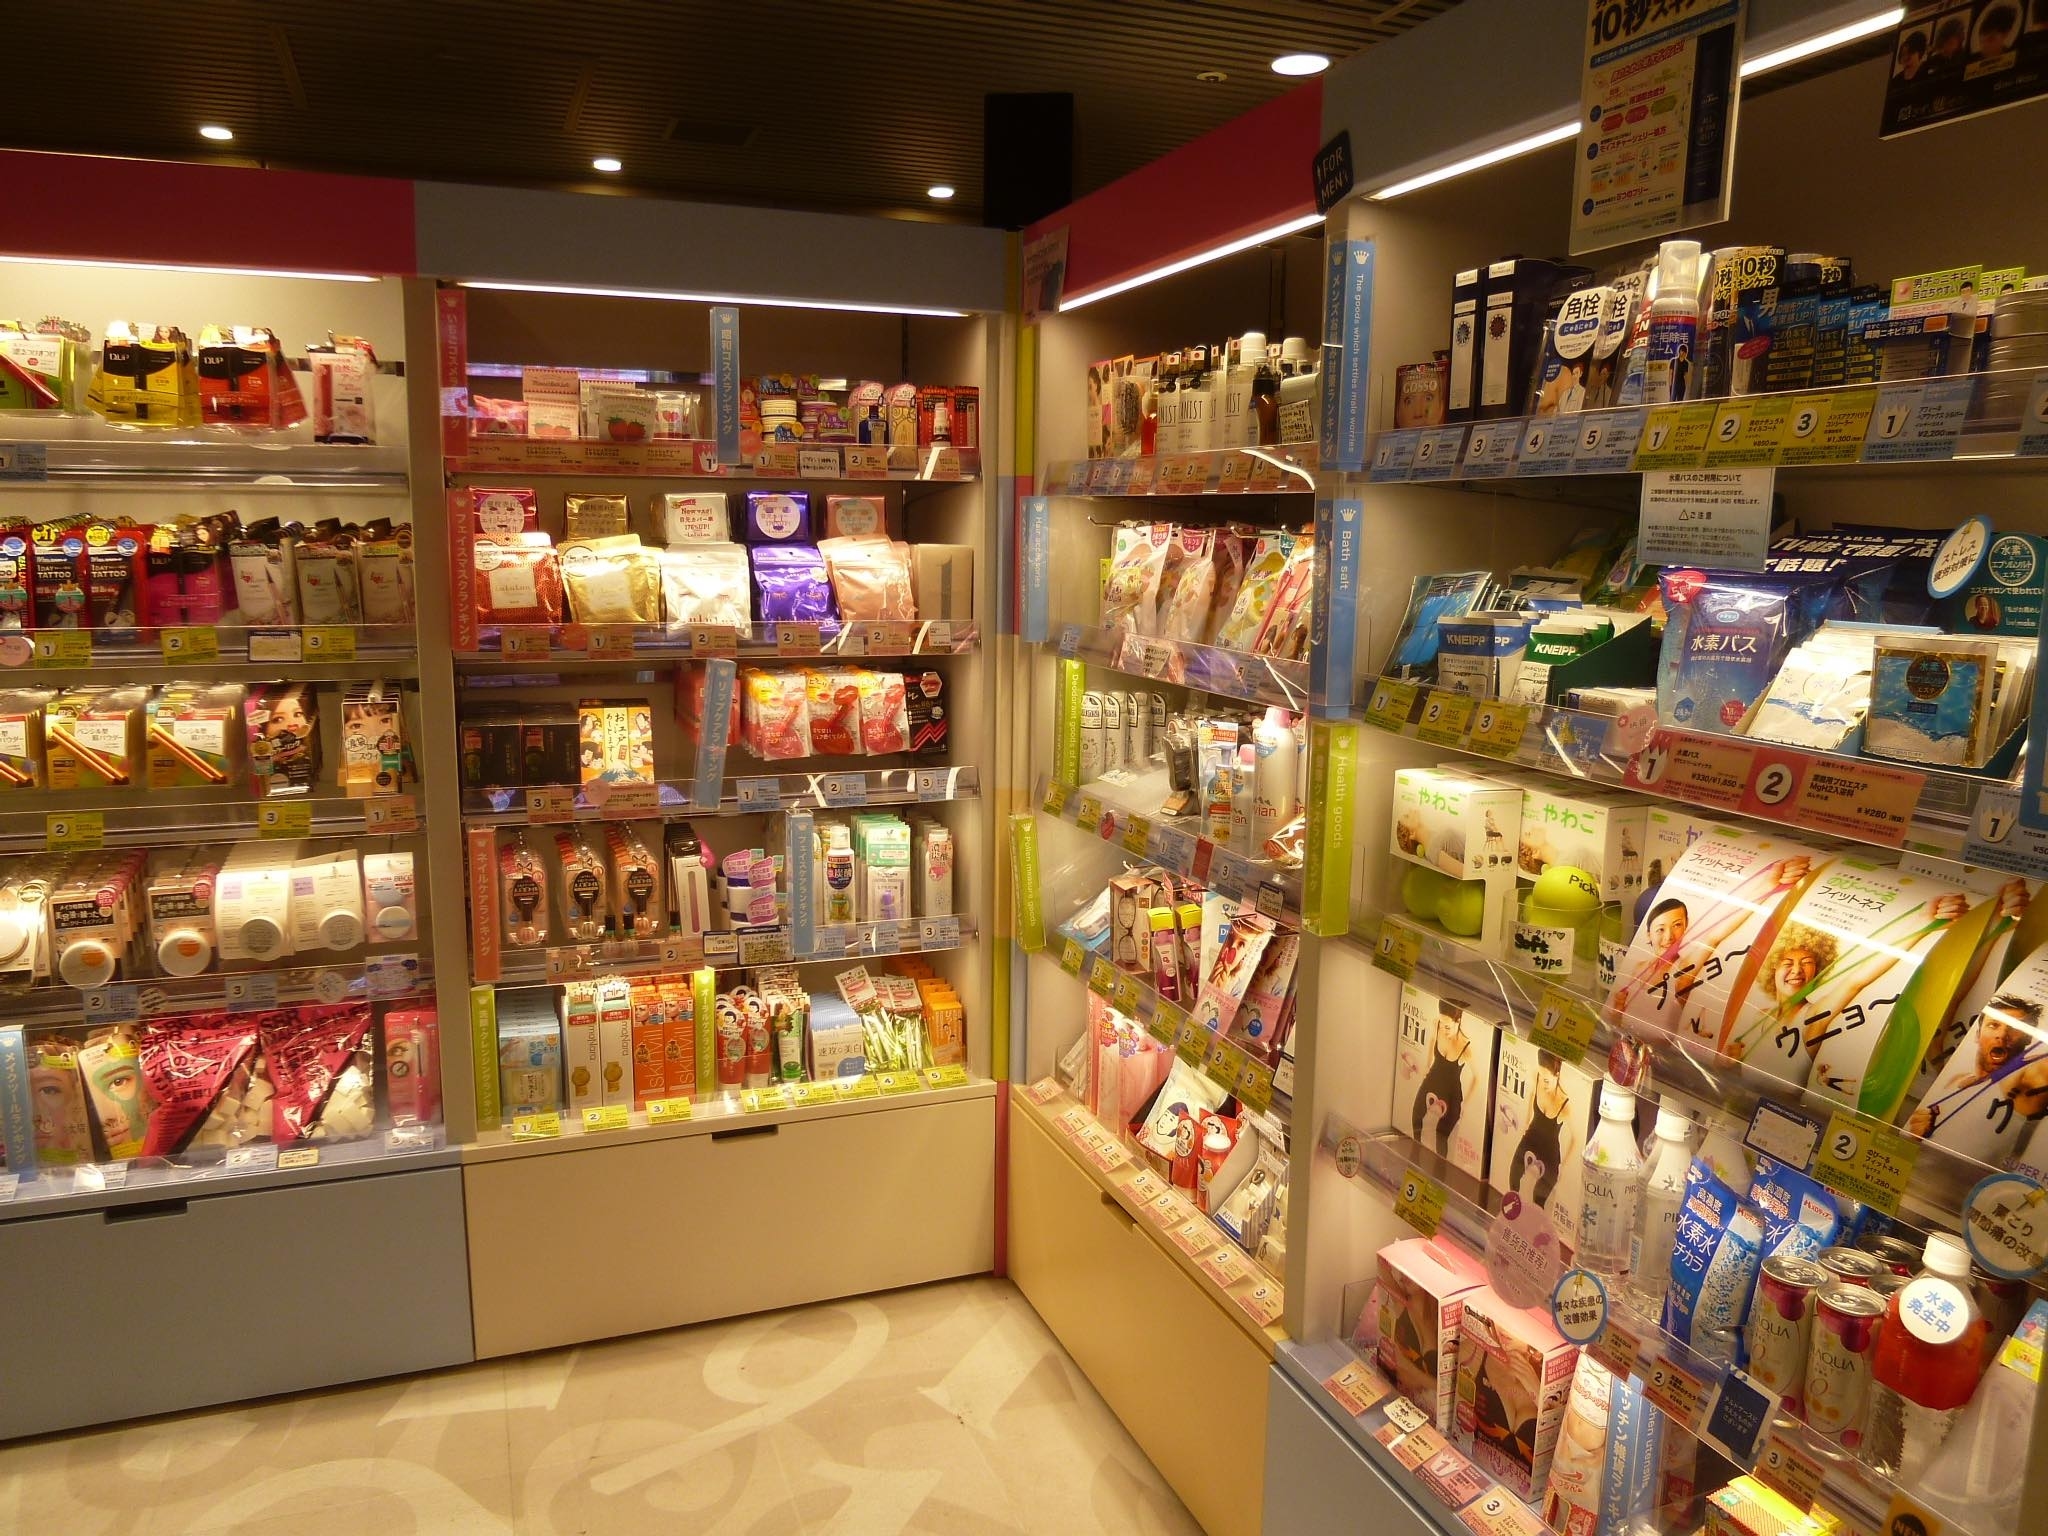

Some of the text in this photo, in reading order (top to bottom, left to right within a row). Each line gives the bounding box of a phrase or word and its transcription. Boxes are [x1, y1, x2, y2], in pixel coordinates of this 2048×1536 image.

[1323, 147, 1342, 179] FOR
[1739, 254, 1776, 277] 10秒
[1354, 294, 1362, 324] goods
[1565, 292, 1599, 321] 角栓
[1758, 287, 1780, 318] 男
[1351, 357, 1359, 389] settles
[1402, 381, 1438, 394] GOSSO
[1350, 391, 1358, 414] male
[1721, 420, 1736, 436] 2
[1798, 413, 1812, 431] 3
[1886, 415, 1896, 434] 1
[1348, 416, 1356, 453] worries
[1531, 434, 1540, 449] 4
[1586, 429, 1597, 446] 5
[1653, 431, 1660, 447] 1
[1474, 439, 1483, 453] 3
[1035, 517, 1043, 533] Hair
[1339, 530, 1352, 590] Bath salt
[1942, 540, 1977, 565] ストレス
[2001, 544, 2023, 556] 水素
[37, 571, 72, 579] TATTOO
[92, 570, 127, 578] TATTOO
[455, 512, 470, 646] フェイスマスクランキング
[2003, 570, 2023, 579] エステ
[170, 638, 179, 649] 2
[310, 636, 321, 648] 3
[1446, 633, 1487, 646] KNEIPP
[1534, 642, 1577, 657] KNEIPP
[1690, 634, 1757, 653] 水素バス
[1071, 675, 1080, 719] Deodorant
[1429, 704, 1438, 717] 2
[1481, 713, 1490, 731] 3
[1069, 721, 1077, 748] goods
[1645, 757, 1658, 780] 1
[1762, 771, 1784, 797] 2
[1333, 756, 1348, 849] Health goods
[1418, 786, 1460, 816] やわこ
[265, 812, 275, 823] 3
[1543, 803, 1596, 834] やわこ
[1863, 808, 1887, 820] ¥280
[55, 824, 65, 835] 2
[1988, 816, 2000, 838] 1
[1024, 836, 1032, 862] Pollen
[1689, 852, 1745, 876] フィットネス
[1817, 885, 1886, 913] フィットネス
[1533, 954, 1564, 970] type
[233, 985, 242, 995] 3
[90, 997, 99, 1007] 2
[1403, 1013, 1426, 1046] Fit
[1503, 1063, 1525, 1099] Fit
[1834, 1134, 1851, 1155] 2
[1865, 1155, 1901, 1177] フィットネス
[2003, 1156, 2040, 1180] SUPER
[1406, 1183, 1415, 1197] 3
[1865, 1172, 1890, 1190] ¥1,280
[1696, 1187, 1725, 1215] 高濃度
[1991, 1203, 2034, 1237] 肩こり
[1676, 1213, 1716, 1257] 水素水
[1923, 1288, 1956, 1317] 水素
[1563, 1309, 1598, 1326] 改善効果
[1906, 1296, 1952, 1335] 発生中
[1654, 1371, 1663, 1383] 2
[1769, 1452, 1779, 1465] 3
[1486, 1499, 1500, 1513] 3
